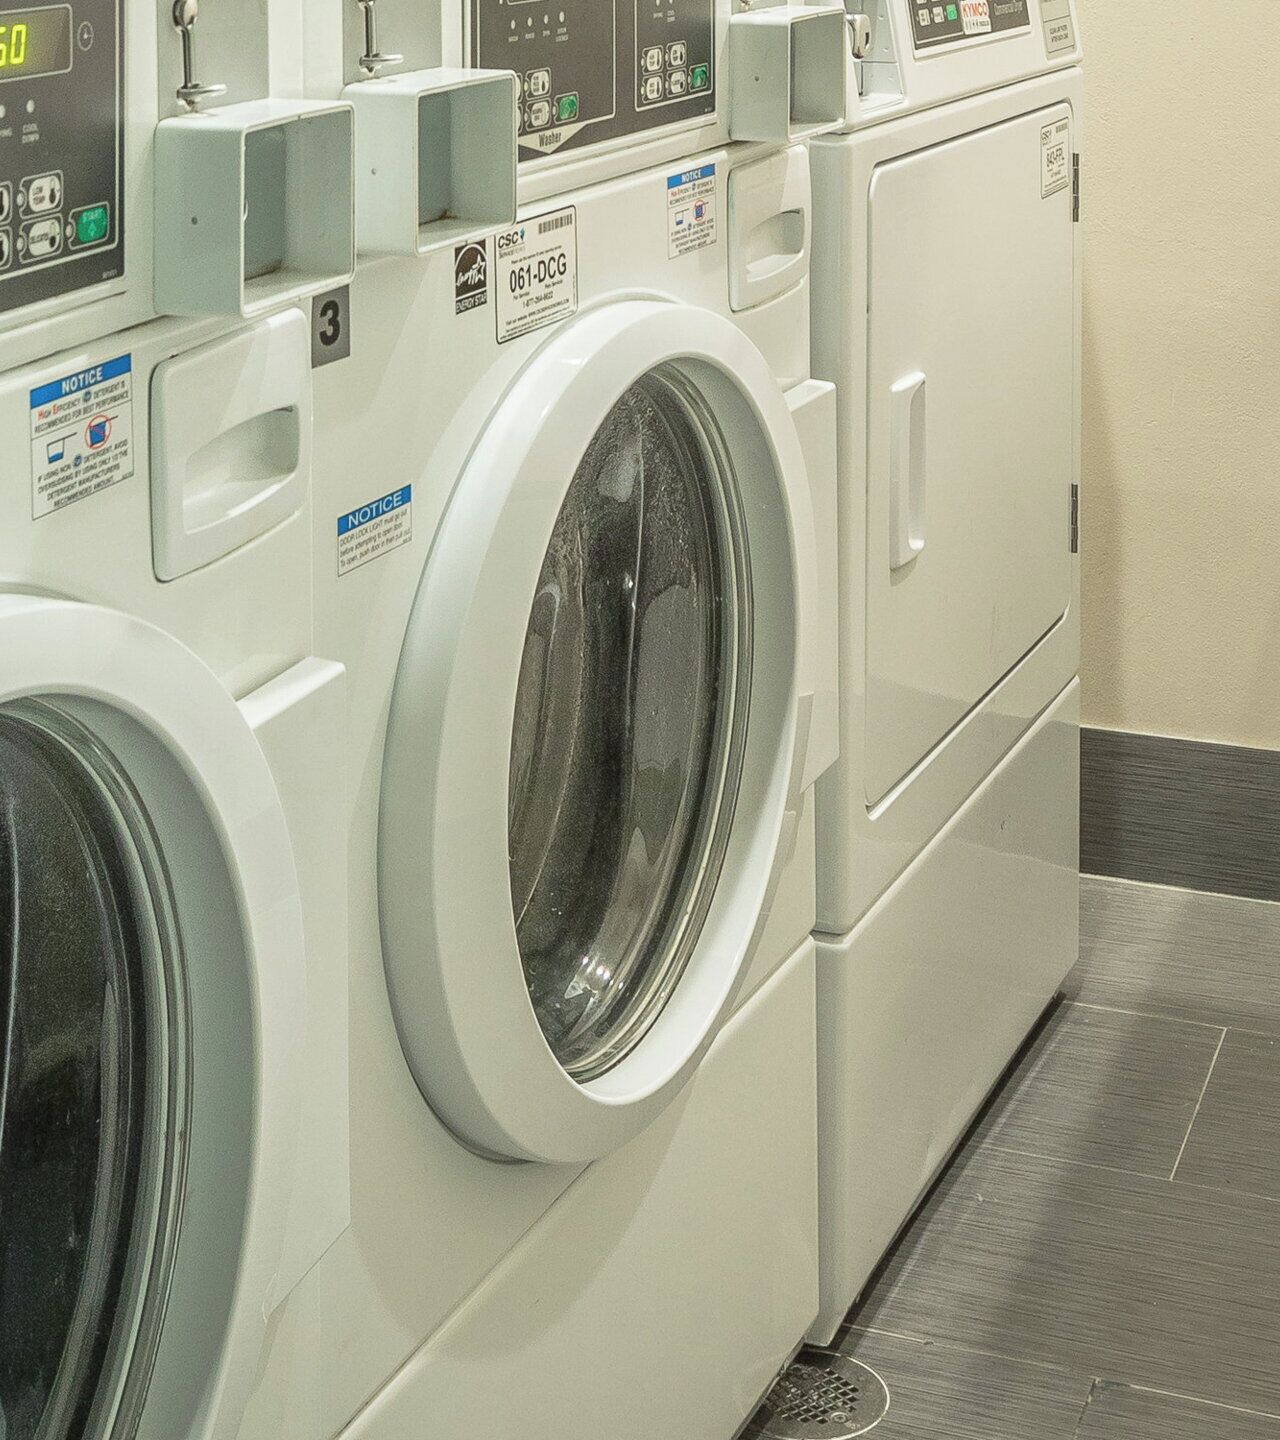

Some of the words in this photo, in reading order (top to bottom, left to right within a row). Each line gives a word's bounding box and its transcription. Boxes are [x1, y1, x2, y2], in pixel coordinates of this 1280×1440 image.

[538, 131, 562, 147] Washer
[681, 166, 702, 183] NOTICE
[497, 231, 519, 249] CSC
[509, 252, 567, 293] 061-DCG
[319, 299, 341, 346] 3
[61, 367, 104, 394] NOTICE
[348, 490, 403, 529] NOTICE
